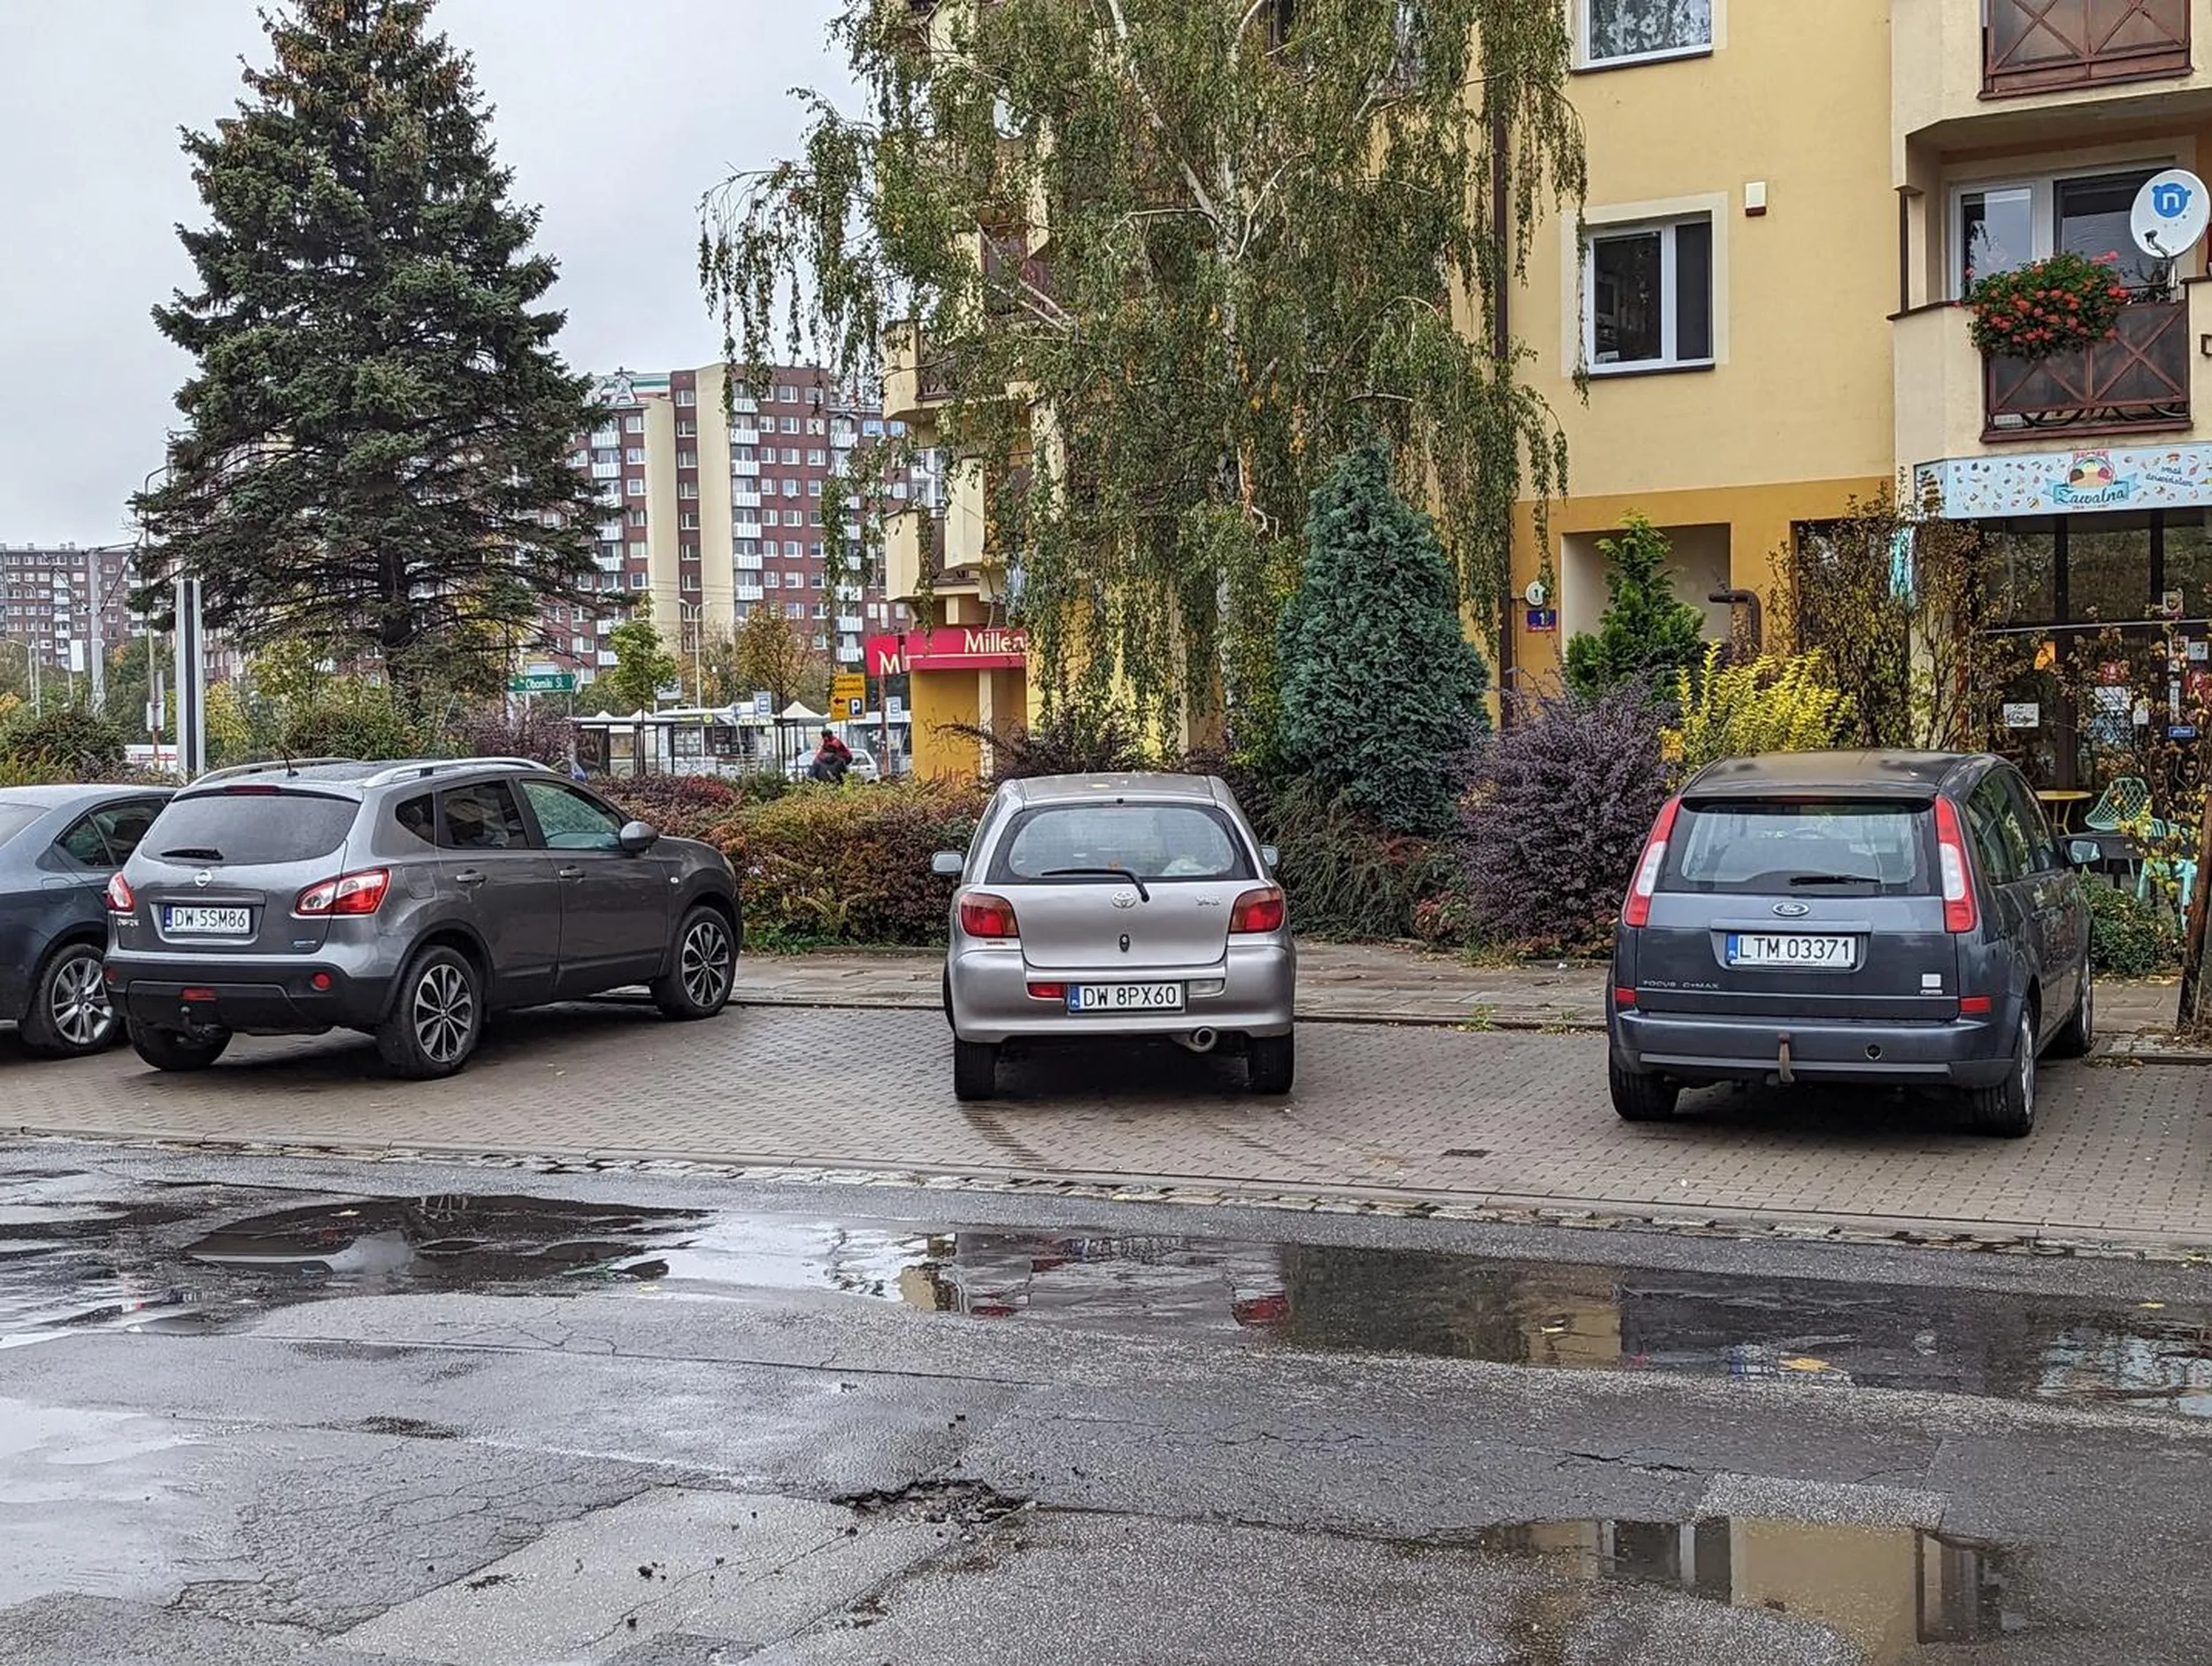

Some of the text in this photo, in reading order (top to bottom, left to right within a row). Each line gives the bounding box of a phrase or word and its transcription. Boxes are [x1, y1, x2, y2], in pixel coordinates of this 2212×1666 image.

[2057, 488, 2124, 505] Zawalna
[878, 650, 901, 675] M
[850, 698, 862, 716] P
[174, 908, 246, 928] DW 5SM86
[1740, 937, 1780, 958] LTM
[1787, 939, 1849, 960] 03371
[1643, 979, 1676, 988] FOCUS
[1084, 987, 1108, 1006] DW
[1117, 986, 1176, 1005] 8PX60
